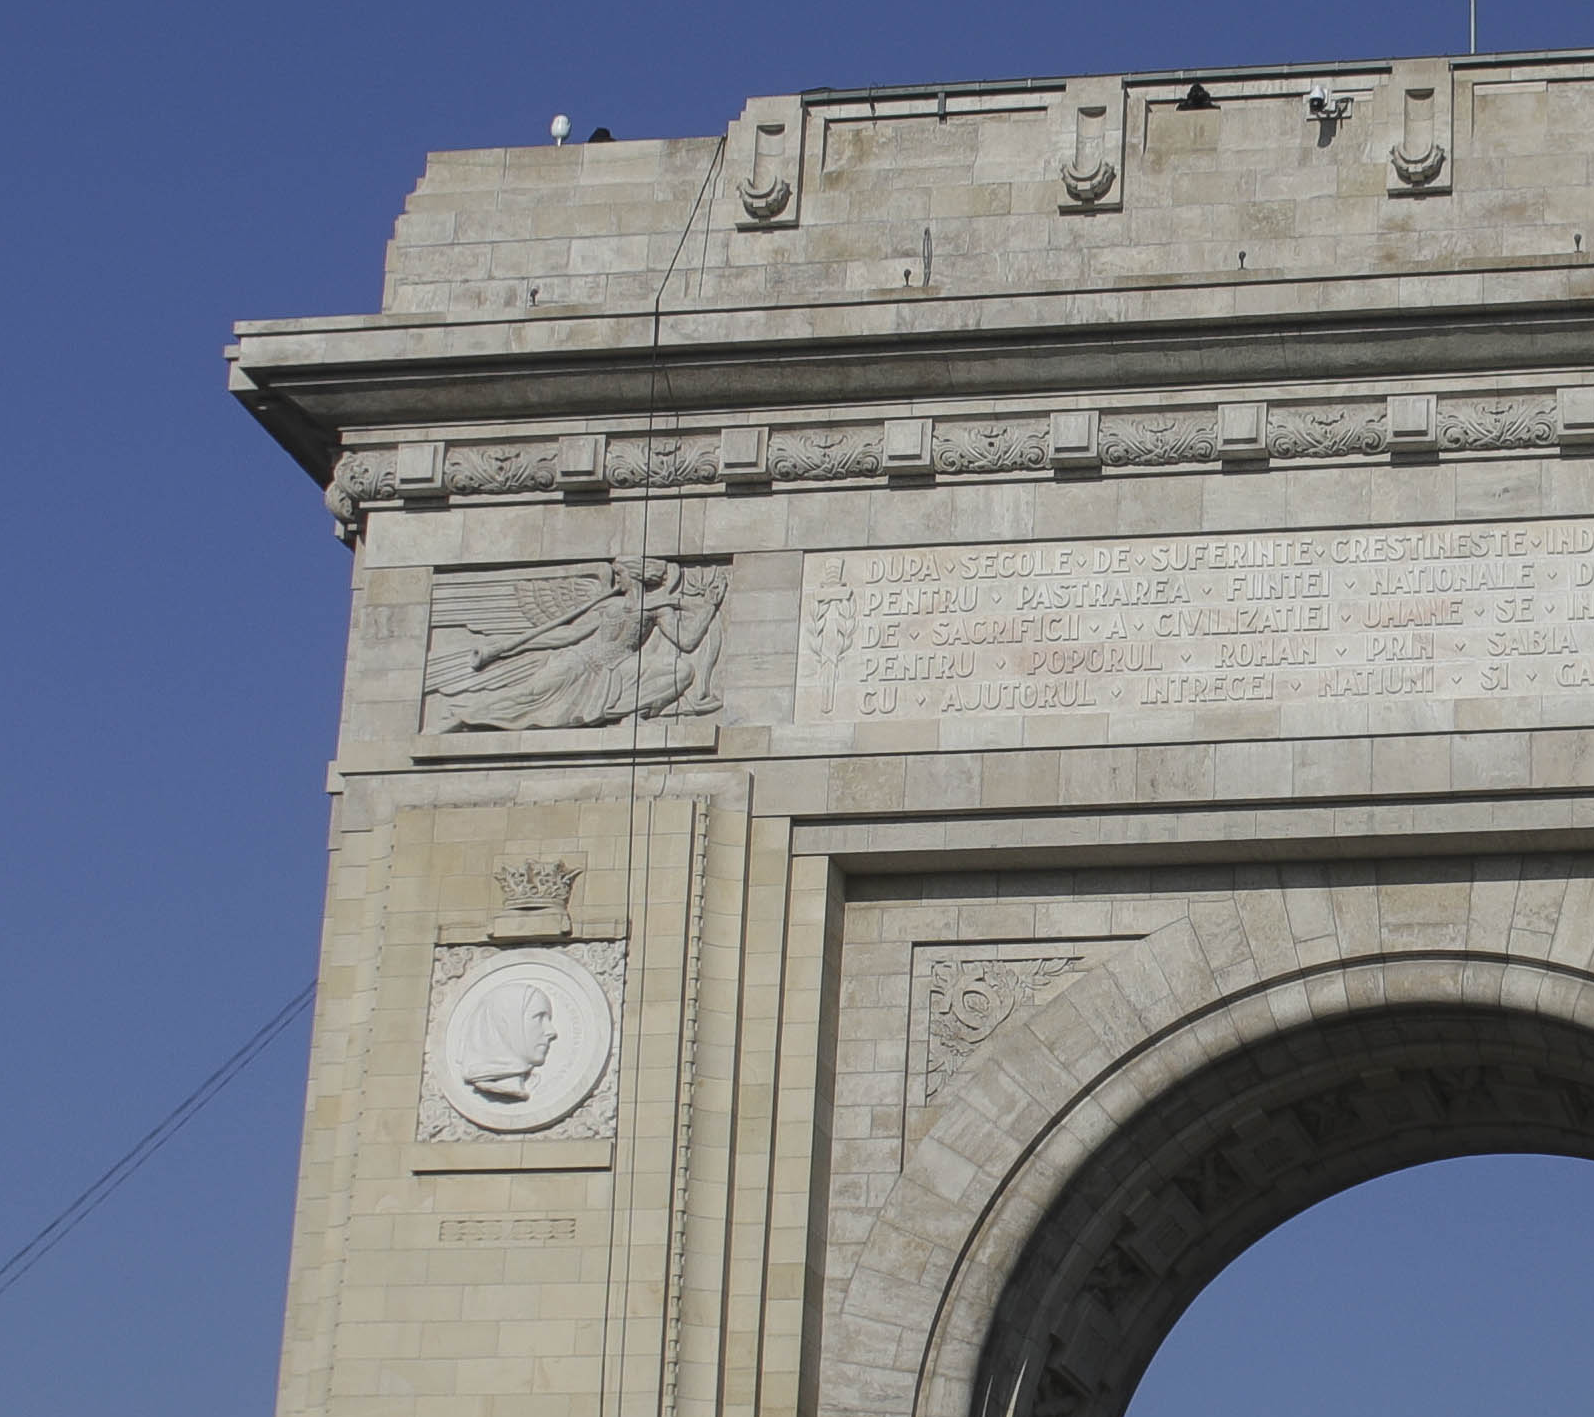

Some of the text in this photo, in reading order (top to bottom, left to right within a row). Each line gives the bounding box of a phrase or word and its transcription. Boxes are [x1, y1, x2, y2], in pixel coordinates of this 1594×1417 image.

[865, 554, 940, 584] DUPA
[959, 548, 1073, 579] SECOLE
[1093, 545, 1132, 574] DE
[1151, 536, 1314, 571] SUFERINTE
[1330, 528, 1527, 564] CRESTINESTE
[863, 583, 978, 617] PENTRU
[1016, 579, 1190, 612] PASTRAREA
[1226, 570, 1330, 602] FIINTEI
[1369, 562, 1535, 596] NATIONALE
[861, 621, 900, 650] DE
[931, 614, 1080, 646] SACRIFICII
[1105, 613, 1128, 640] A
[1155, 604, 1331, 638] CIVILIZATIEI
[1495, 595, 1535, 624] SE
[859, 648, 976, 683] PENTRU
[1027, 643, 1163, 676] POPORUL
[1365, 632, 1435, 662] PRIN
[1486, 626, 1578, 657] SABIA
[859, 686, 899, 716] CU
[941, 679, 1097, 713] AJUTORUL
[1317, 666, 1435, 697] NATIUNI
[1480, 663, 1509, 691] SI
